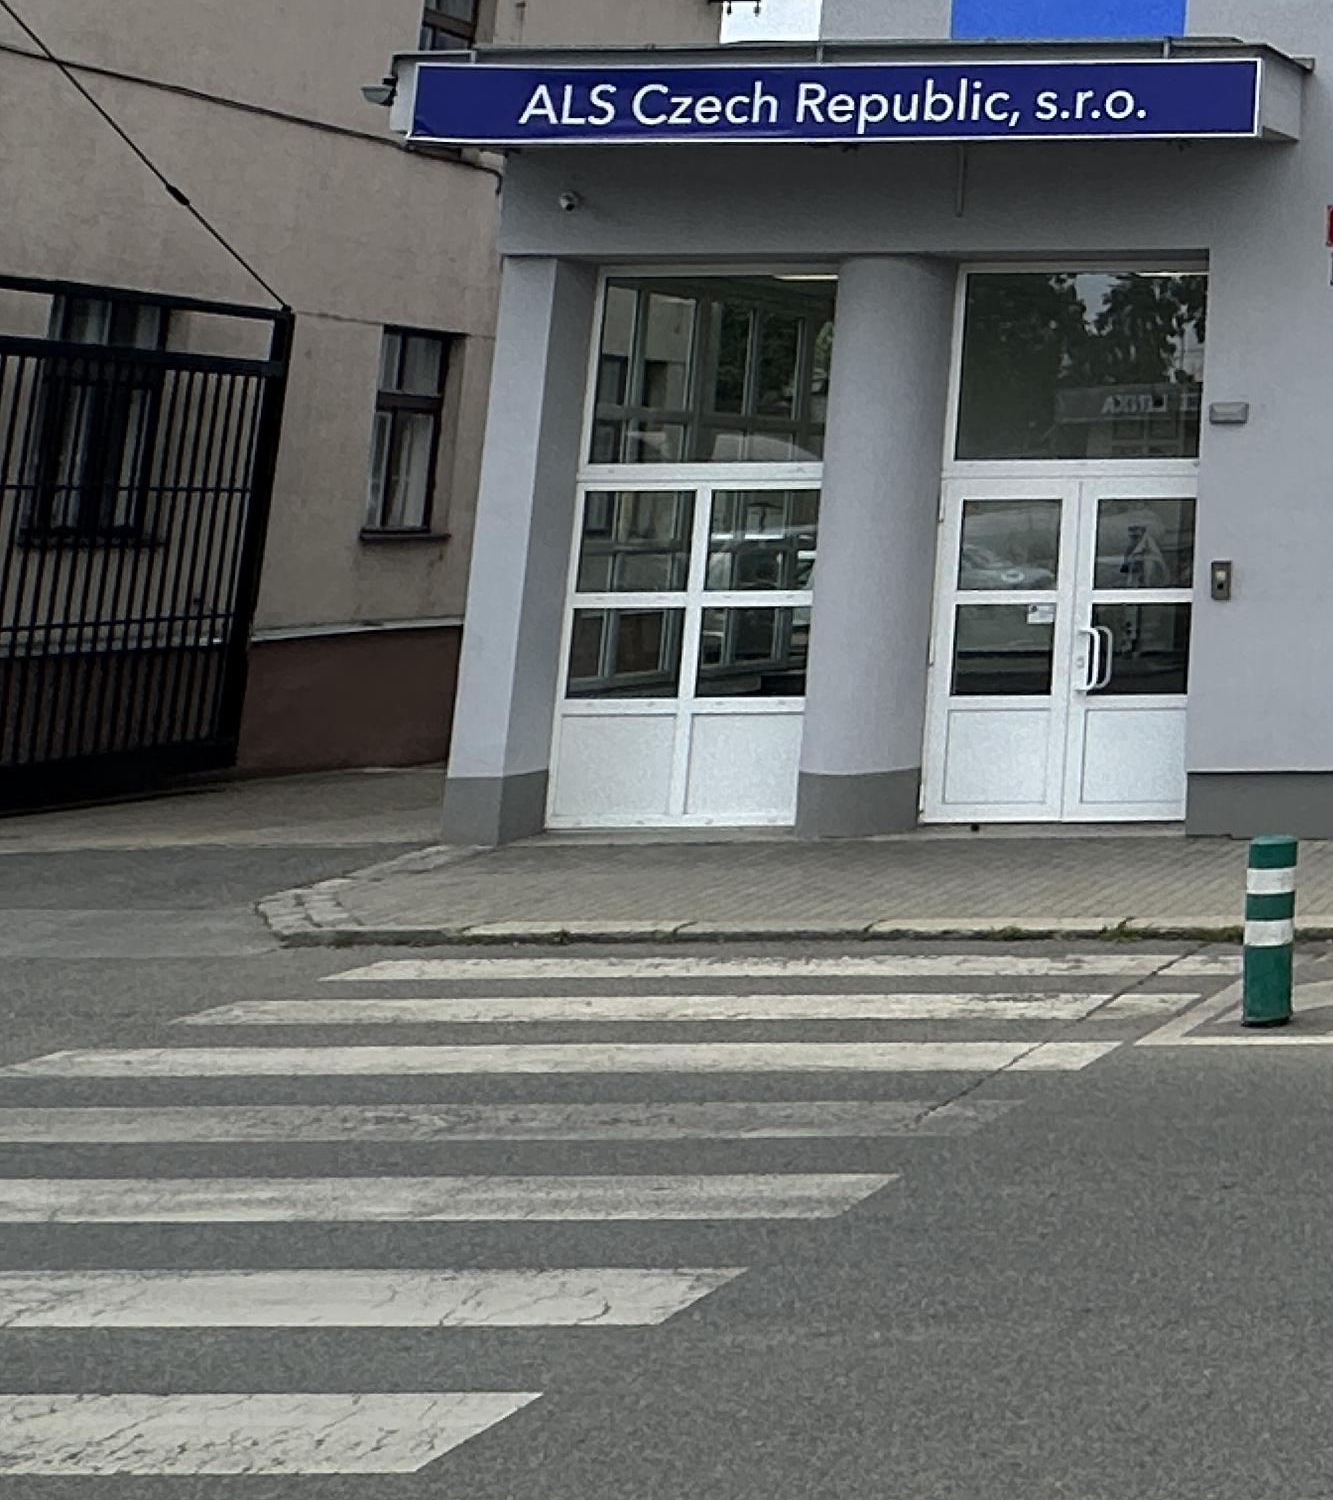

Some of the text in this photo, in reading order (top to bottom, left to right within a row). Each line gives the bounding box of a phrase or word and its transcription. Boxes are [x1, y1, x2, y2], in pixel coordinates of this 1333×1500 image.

[518, 78, 1147, 135] ALS Czech Republic, s.r.o.
